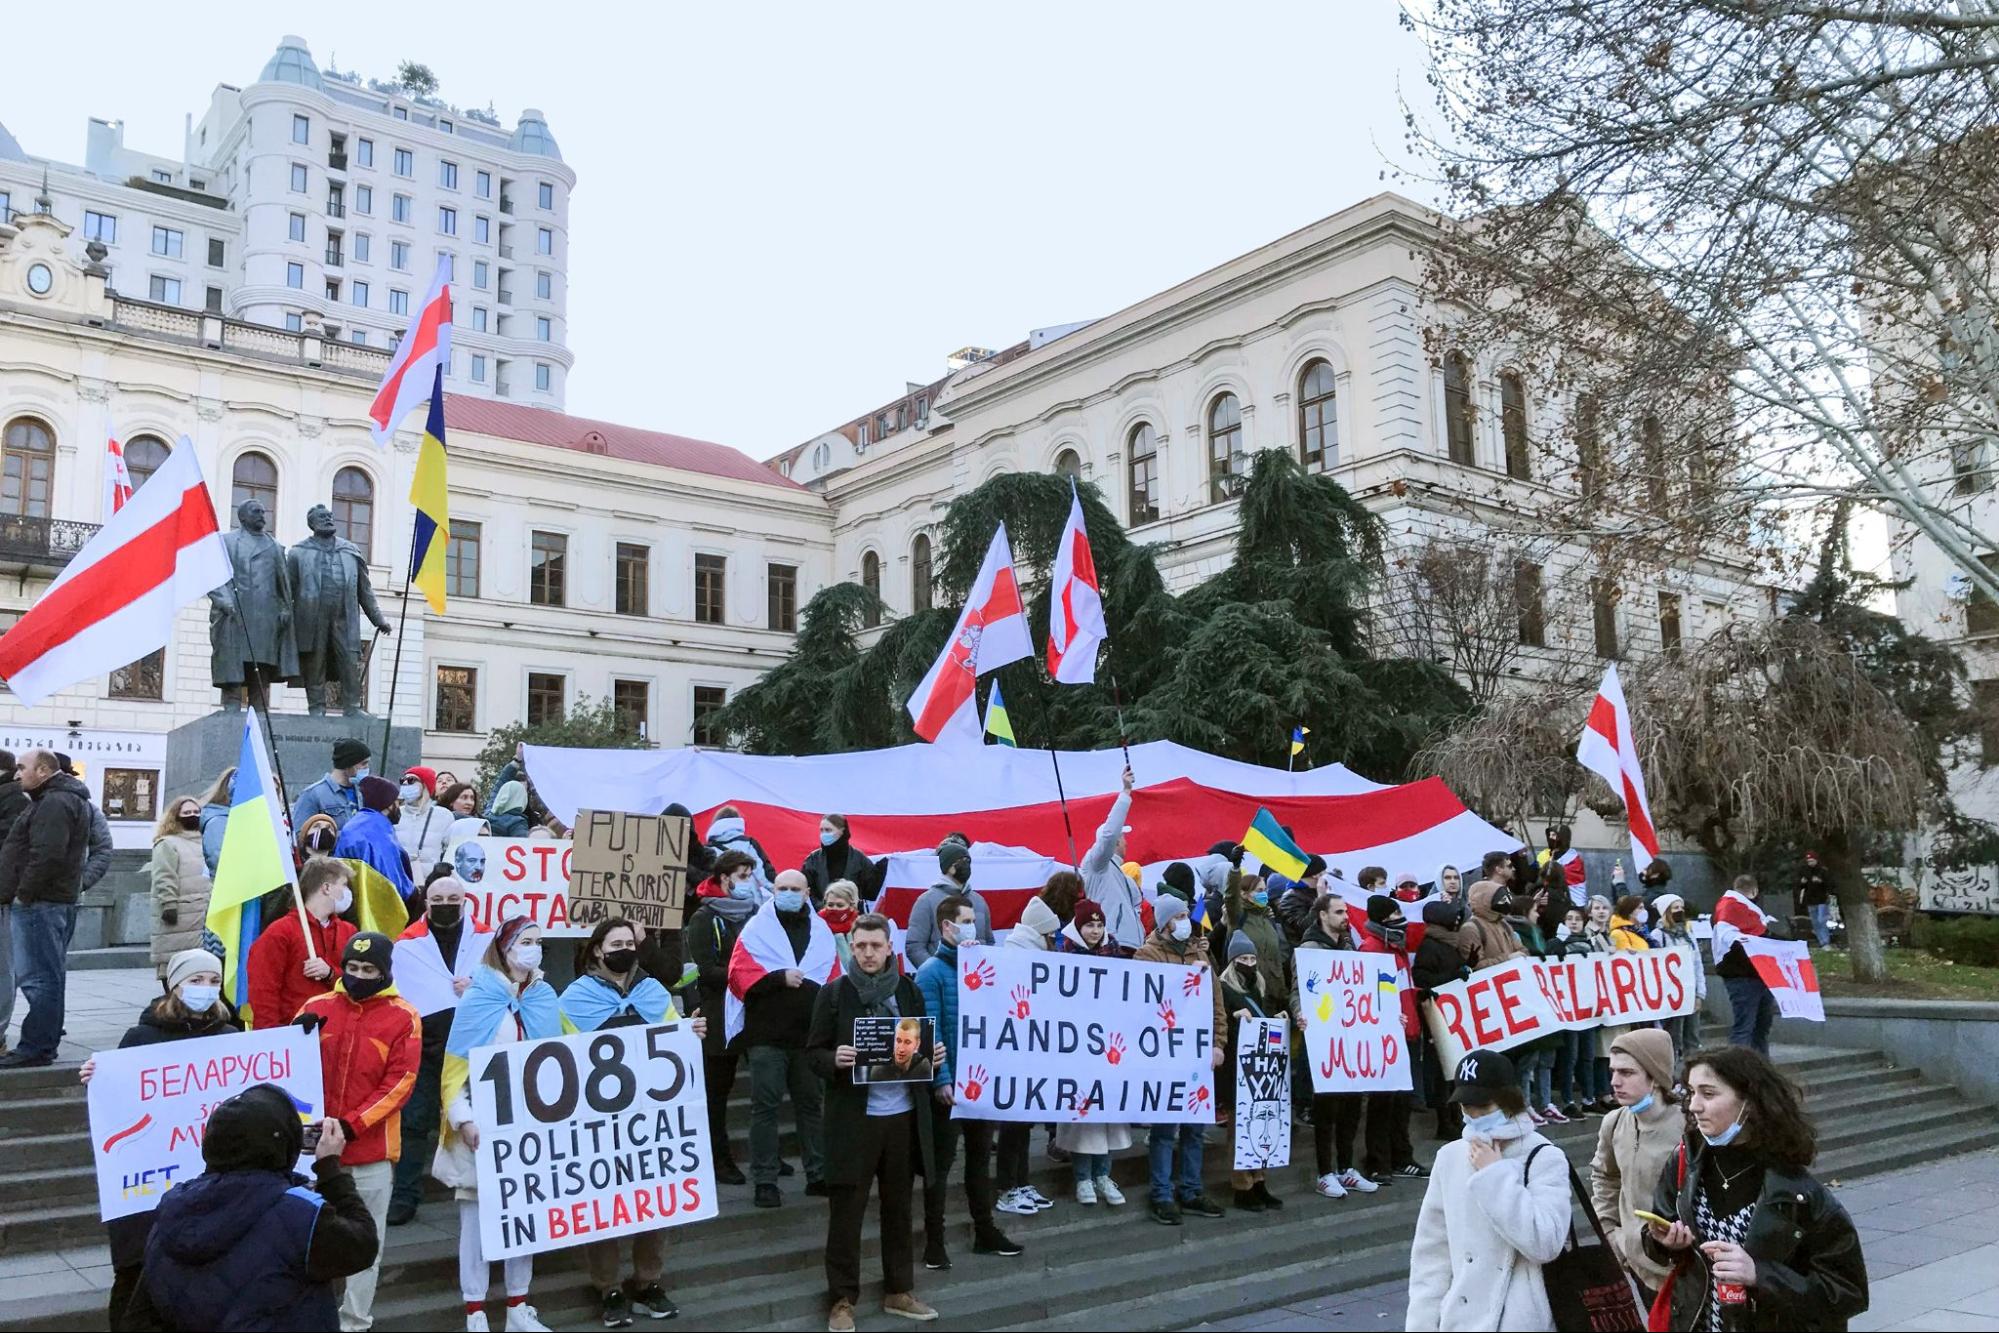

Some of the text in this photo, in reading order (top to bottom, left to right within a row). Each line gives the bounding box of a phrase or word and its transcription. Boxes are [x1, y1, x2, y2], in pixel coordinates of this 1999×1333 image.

[588, 810, 684, 861] PUTIN
[621, 853, 635, 874] IS
[571, 865, 687, 906] TERRORIST
[464, 892, 588, 930] DICTA
[1031, 962, 1165, 1004] PUTIN
[1532, 952, 1684, 1023] BELARUS
[961, 1014, 1210, 1059] HANDS OFF
[140, 1048, 291, 1101] БЕЛАРУСЫ
[479, 1023, 686, 1127] 1085
[1459, 1058, 1479, 1081] NY
[993, 1075, 1188, 1114] UKRAINE
[122, 1164, 181, 1201] НЕТ
[548, 1177, 702, 1239] BELARUS
